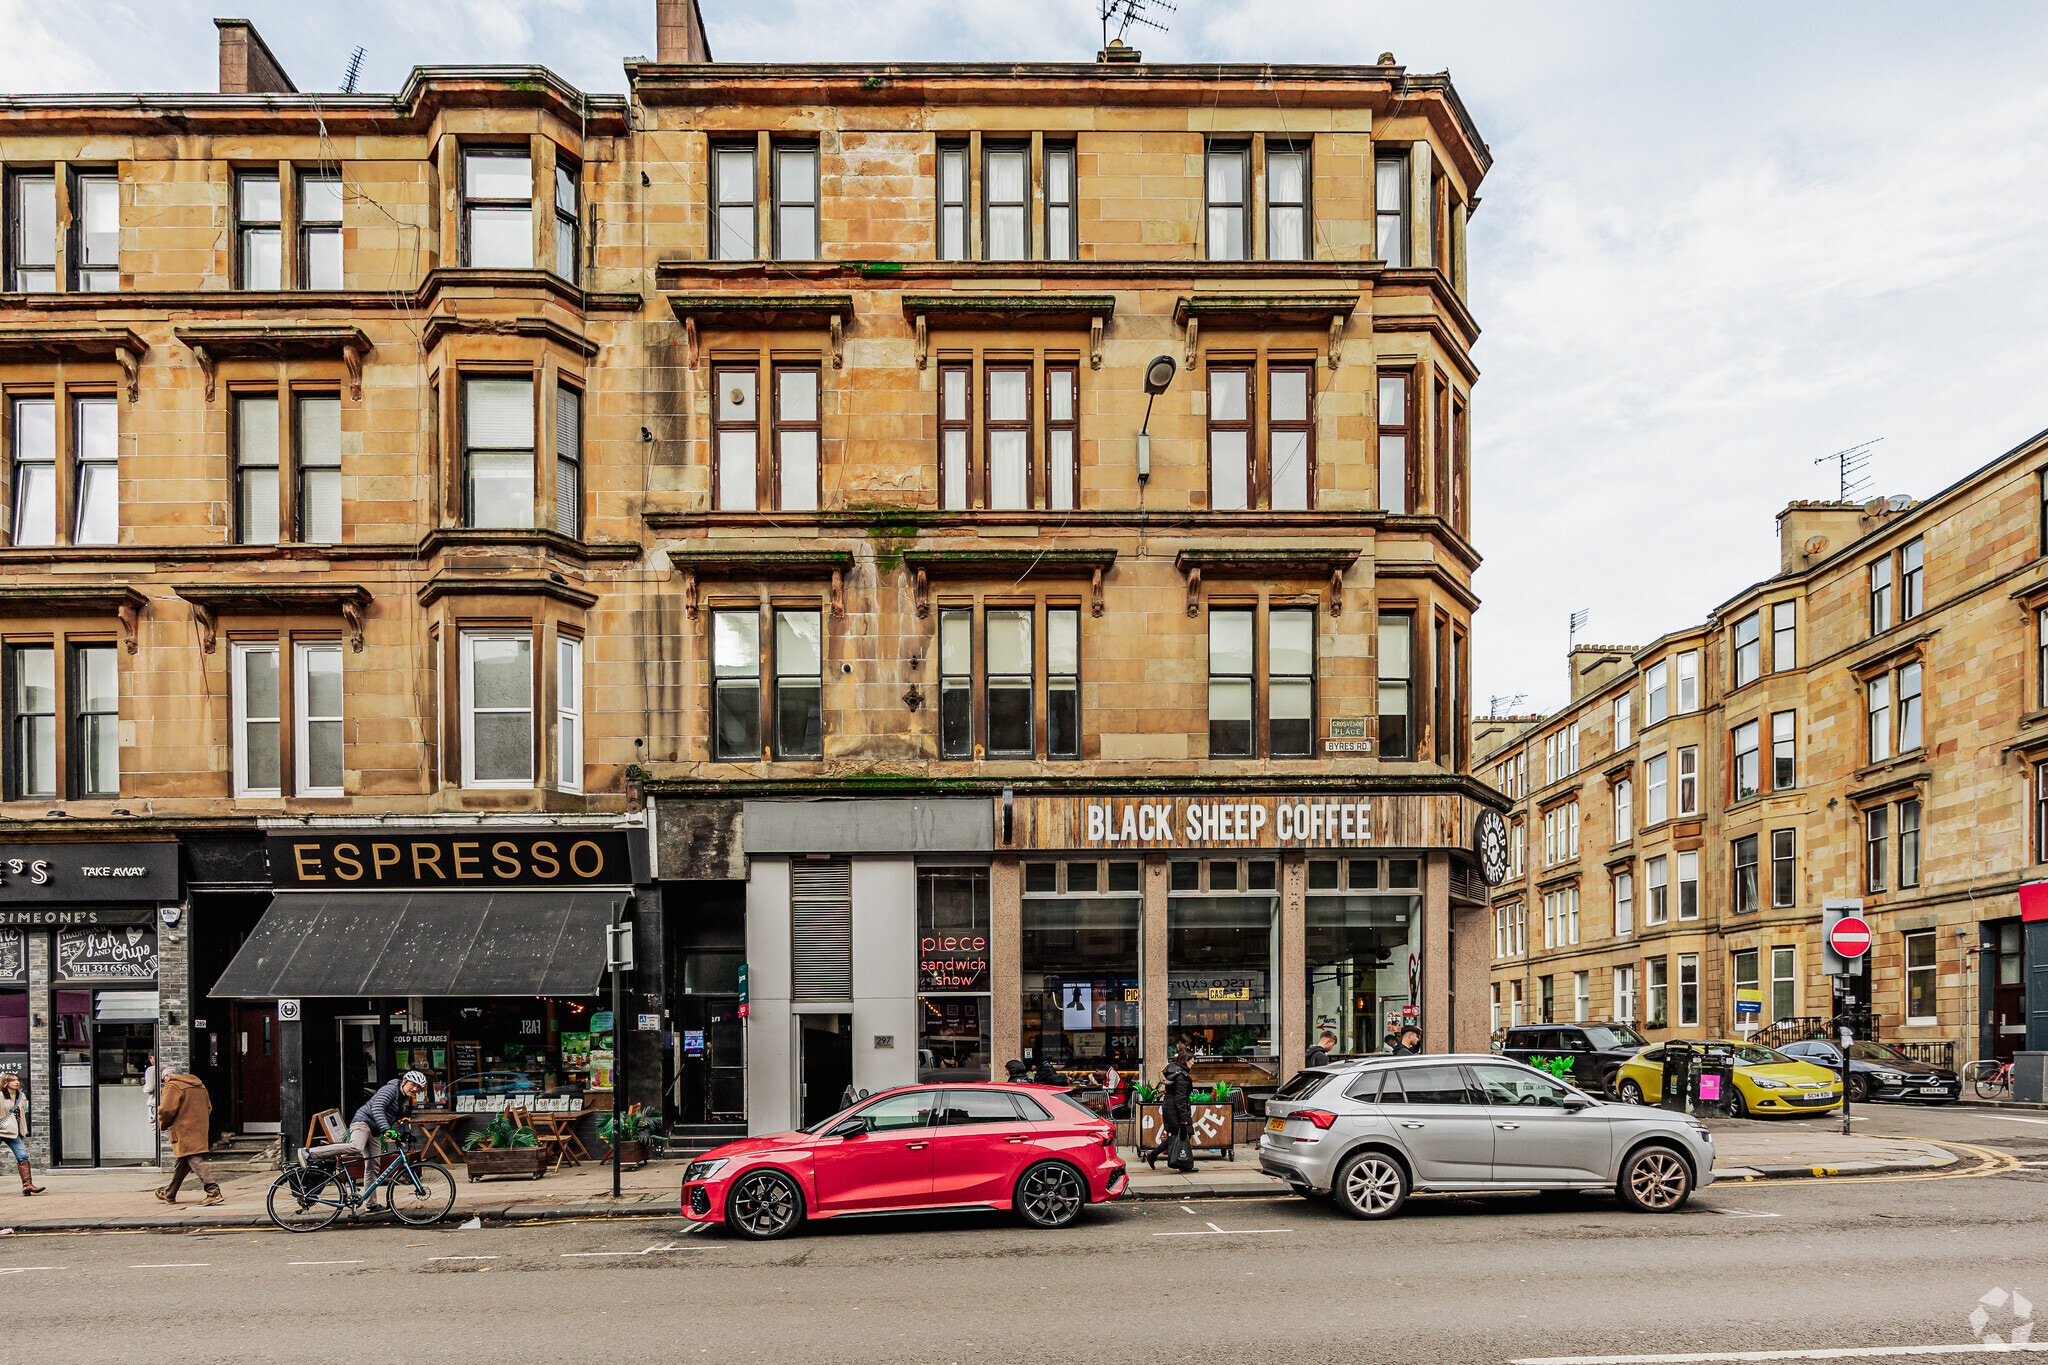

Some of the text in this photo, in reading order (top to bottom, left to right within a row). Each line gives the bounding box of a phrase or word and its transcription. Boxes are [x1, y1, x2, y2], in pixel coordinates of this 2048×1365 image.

[1335, 728, 1361, 736] PLACE
[1328, 742, 1369, 751] BYRES RD.
[1088, 803, 1372, 841] BLACK SHEEP COFFEE
[293, 840, 604, 882] ESPRESSO
[81, 866, 111, 877] TAKE
[112, 866, 146, 877] AWAY
[0, 911, 98, 924] SIMEONE'S
[61, 925, 108, 940] TRADITIONAL
[921, 931, 986, 958] piece
[93, 943, 151, 962] AND Chips
[72, 963, 131, 973] 0141 334 6561
[920, 956, 986, 971] sandwich
[936, 972, 972, 986] show
[393, 1035, 448, 1043] COLD BEVERAGES
[876, 1036, 891, 1045] 297
